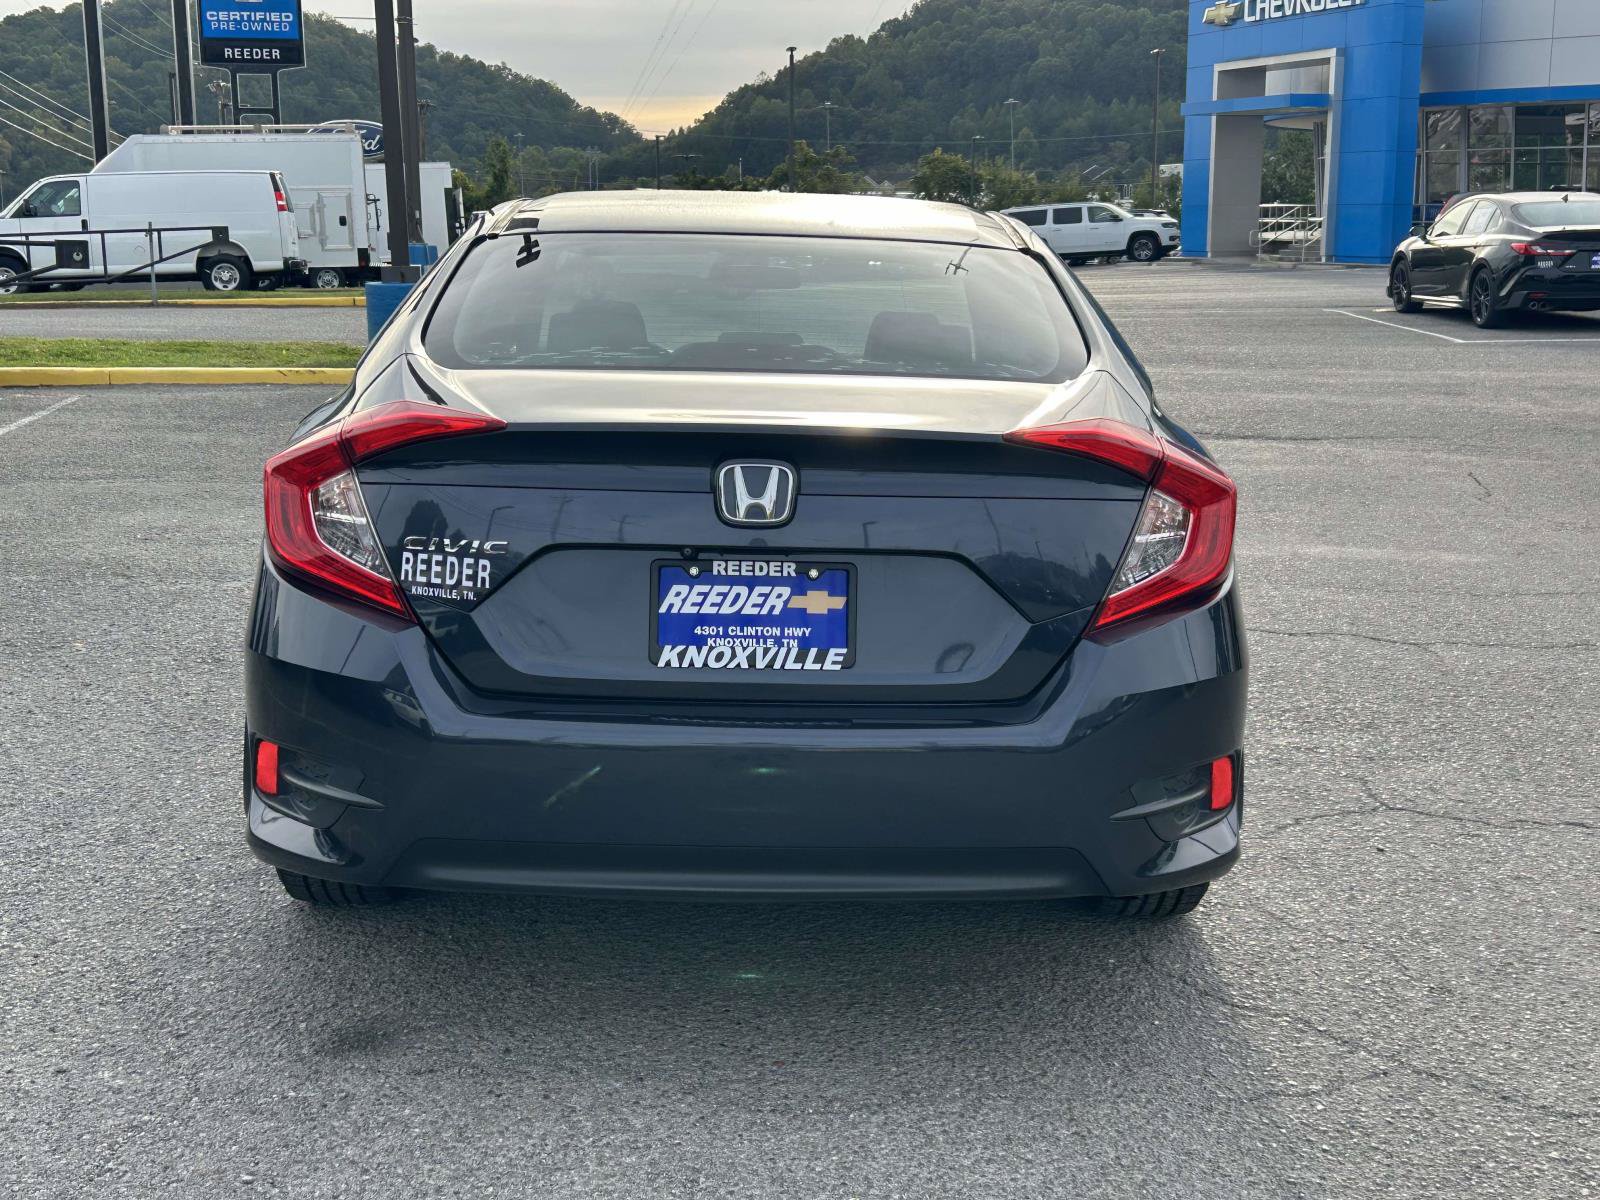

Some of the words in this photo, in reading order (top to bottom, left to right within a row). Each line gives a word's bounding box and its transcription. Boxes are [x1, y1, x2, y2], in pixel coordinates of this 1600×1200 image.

[206, 11, 293, 21] CERTIFIED
[211, 22, 289, 31] PRE-OWNED
[224, 47, 281, 60] REEDER
[404, 536, 509, 554] CIVIC
[400, 551, 491, 589] REEDER
[712, 560, 797, 577] REEDER
[411, 585, 461, 601] KNOXVILLE,
[463, 590, 477, 601] TN.
[658, 584, 791, 615] REEDER
[694, 626, 723, 636] 4301
[728, 626, 781, 636] CLINTON
[785, 627, 812, 637] HWY
[782, 639, 798, 648] TN
[657, 645, 847, 670] KNOXVILLE
